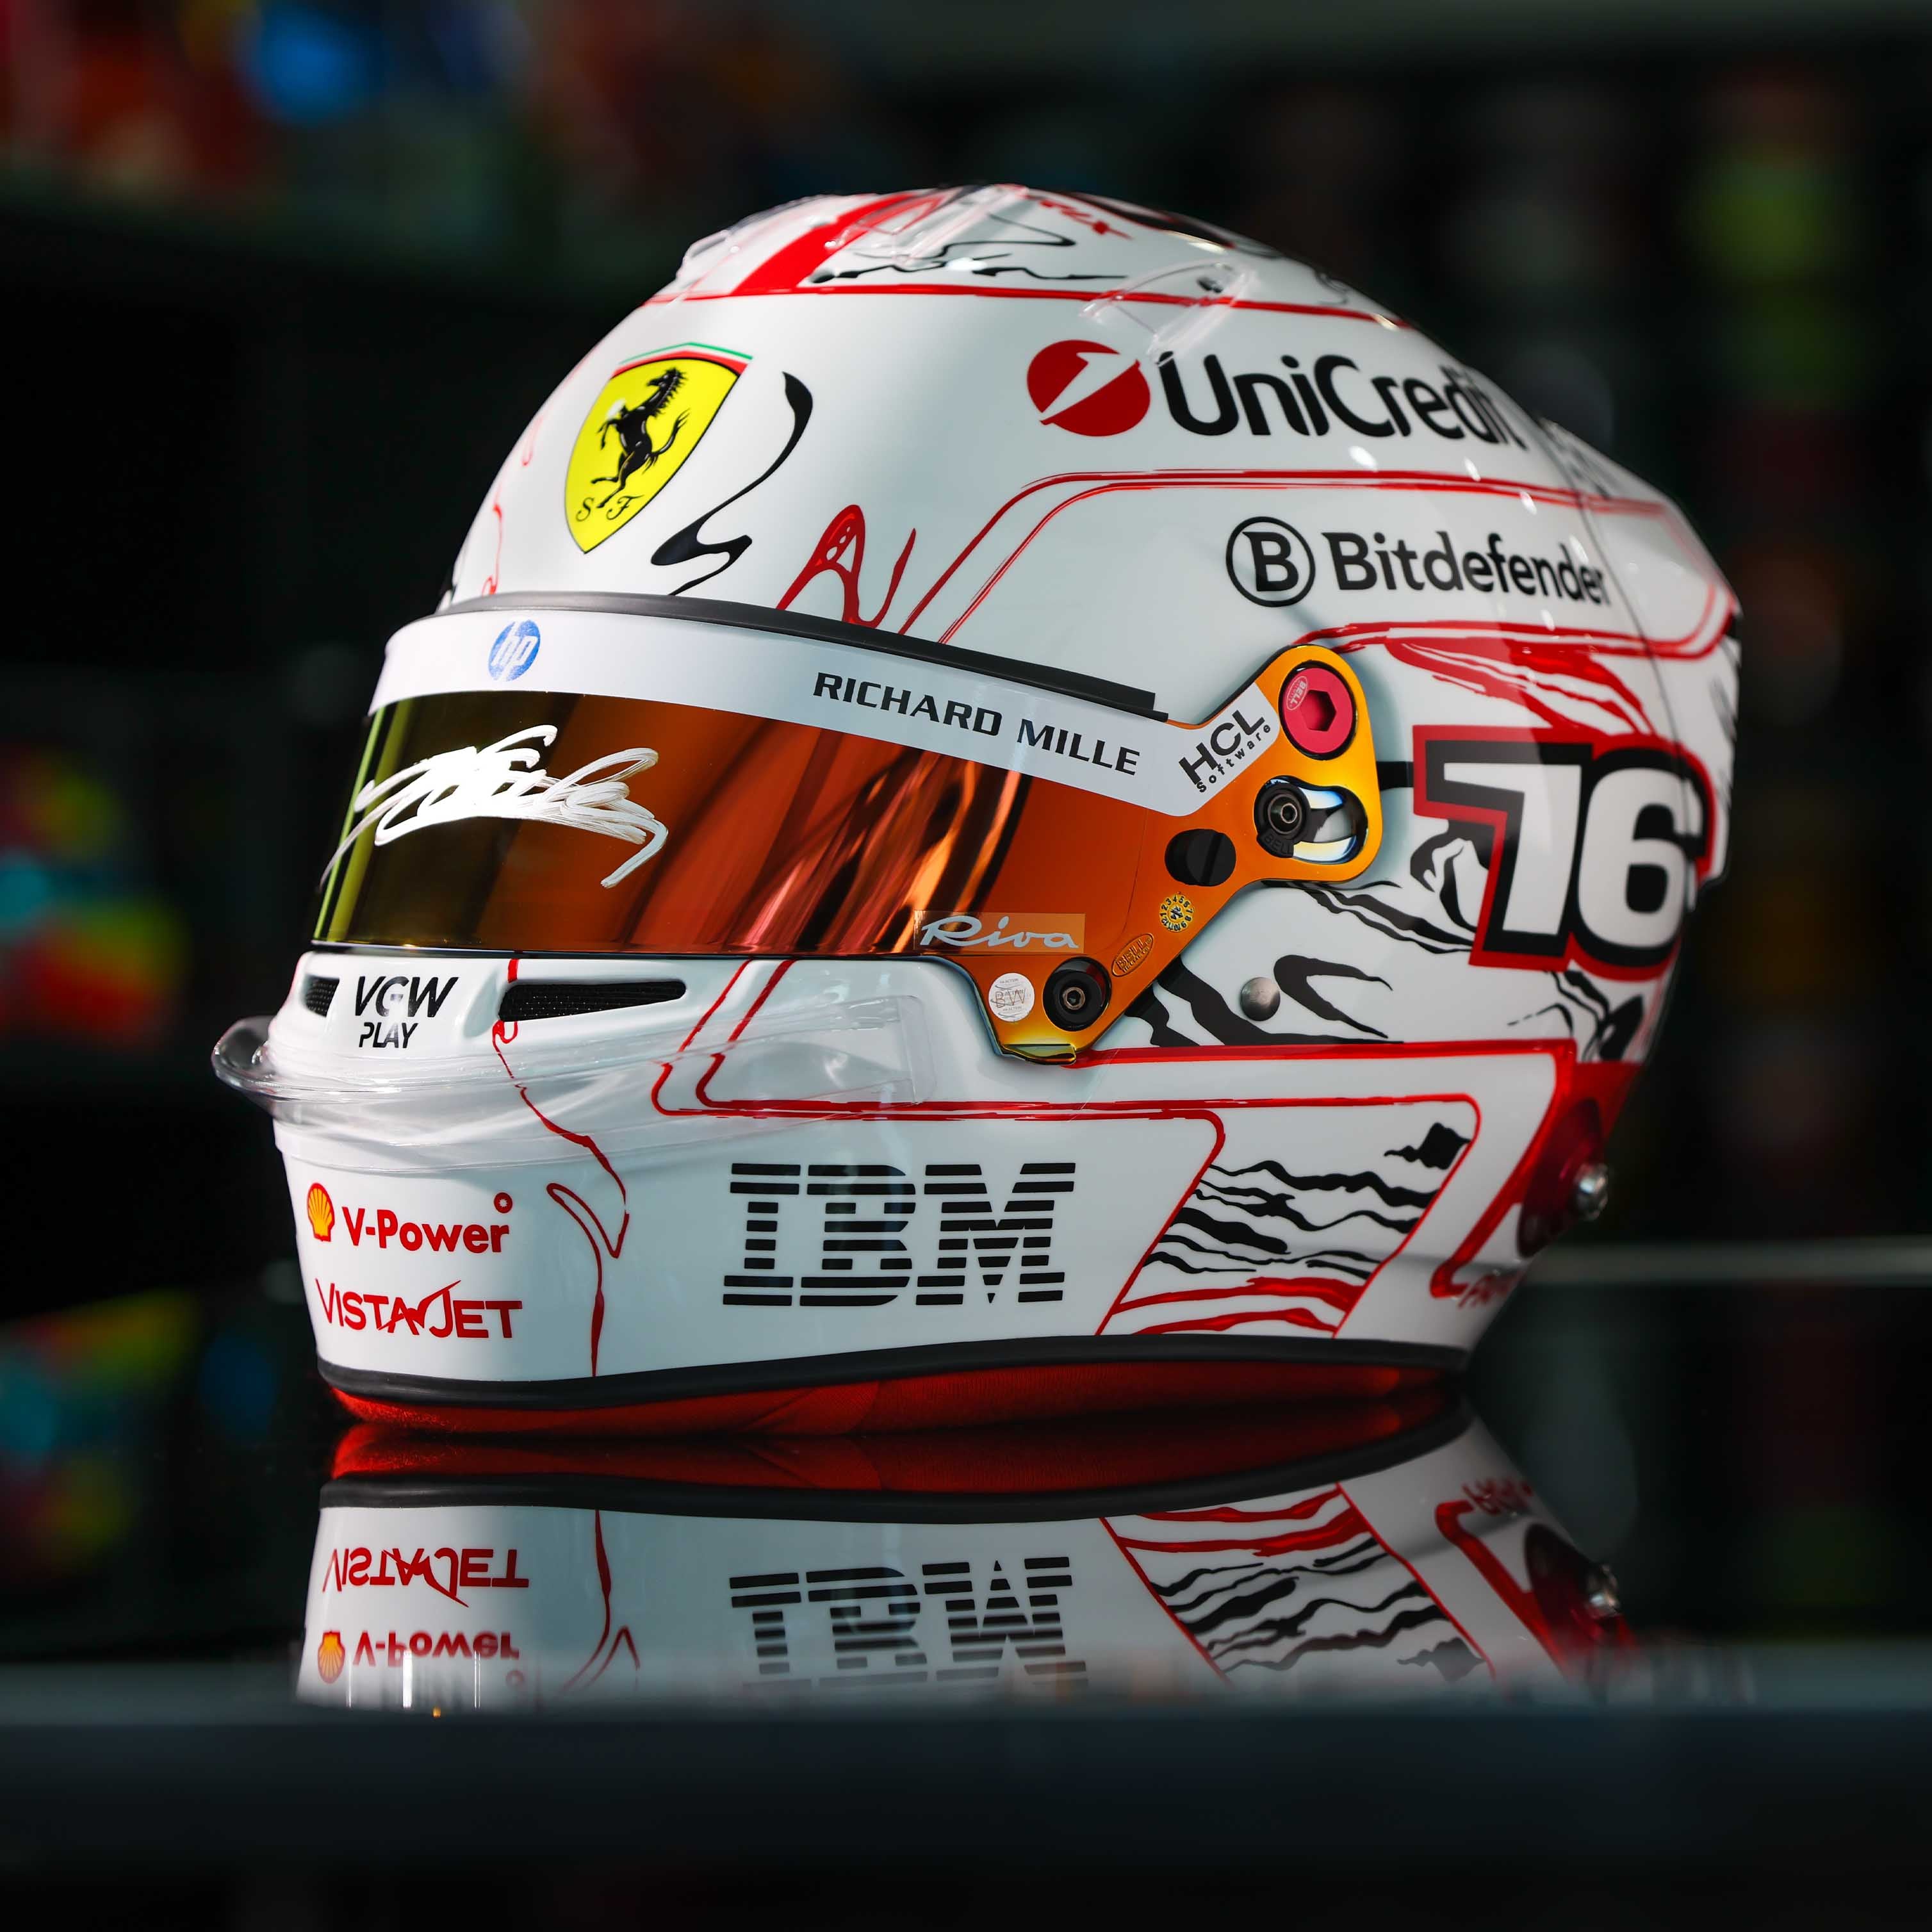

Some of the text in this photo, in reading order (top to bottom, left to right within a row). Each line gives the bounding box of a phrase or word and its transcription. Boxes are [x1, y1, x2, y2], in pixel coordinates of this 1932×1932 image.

[1158, 350, 1528, 451] UniCredit
[577, 495, 644, 521] S F
[1321, 531, 1611, 606] Bitdefender
[812, 672, 1140, 776] RICHARD MILLE
[1289, 681, 1306, 704] BELL
[1179, 709, 1265, 785] HCL
[1196, 724, 1271, 793] Software
[1423, 739, 1709, 969] 76
[920, 916, 1079, 949] Riva
[1115, 938, 1147, 970] BELL
[358, 1022, 418, 1049] PLAY
[342, 1206, 510, 1253] V-Power
[723, 1163, 1076, 1306] IBM
[316, 1280, 523, 1338] VISTAJET
